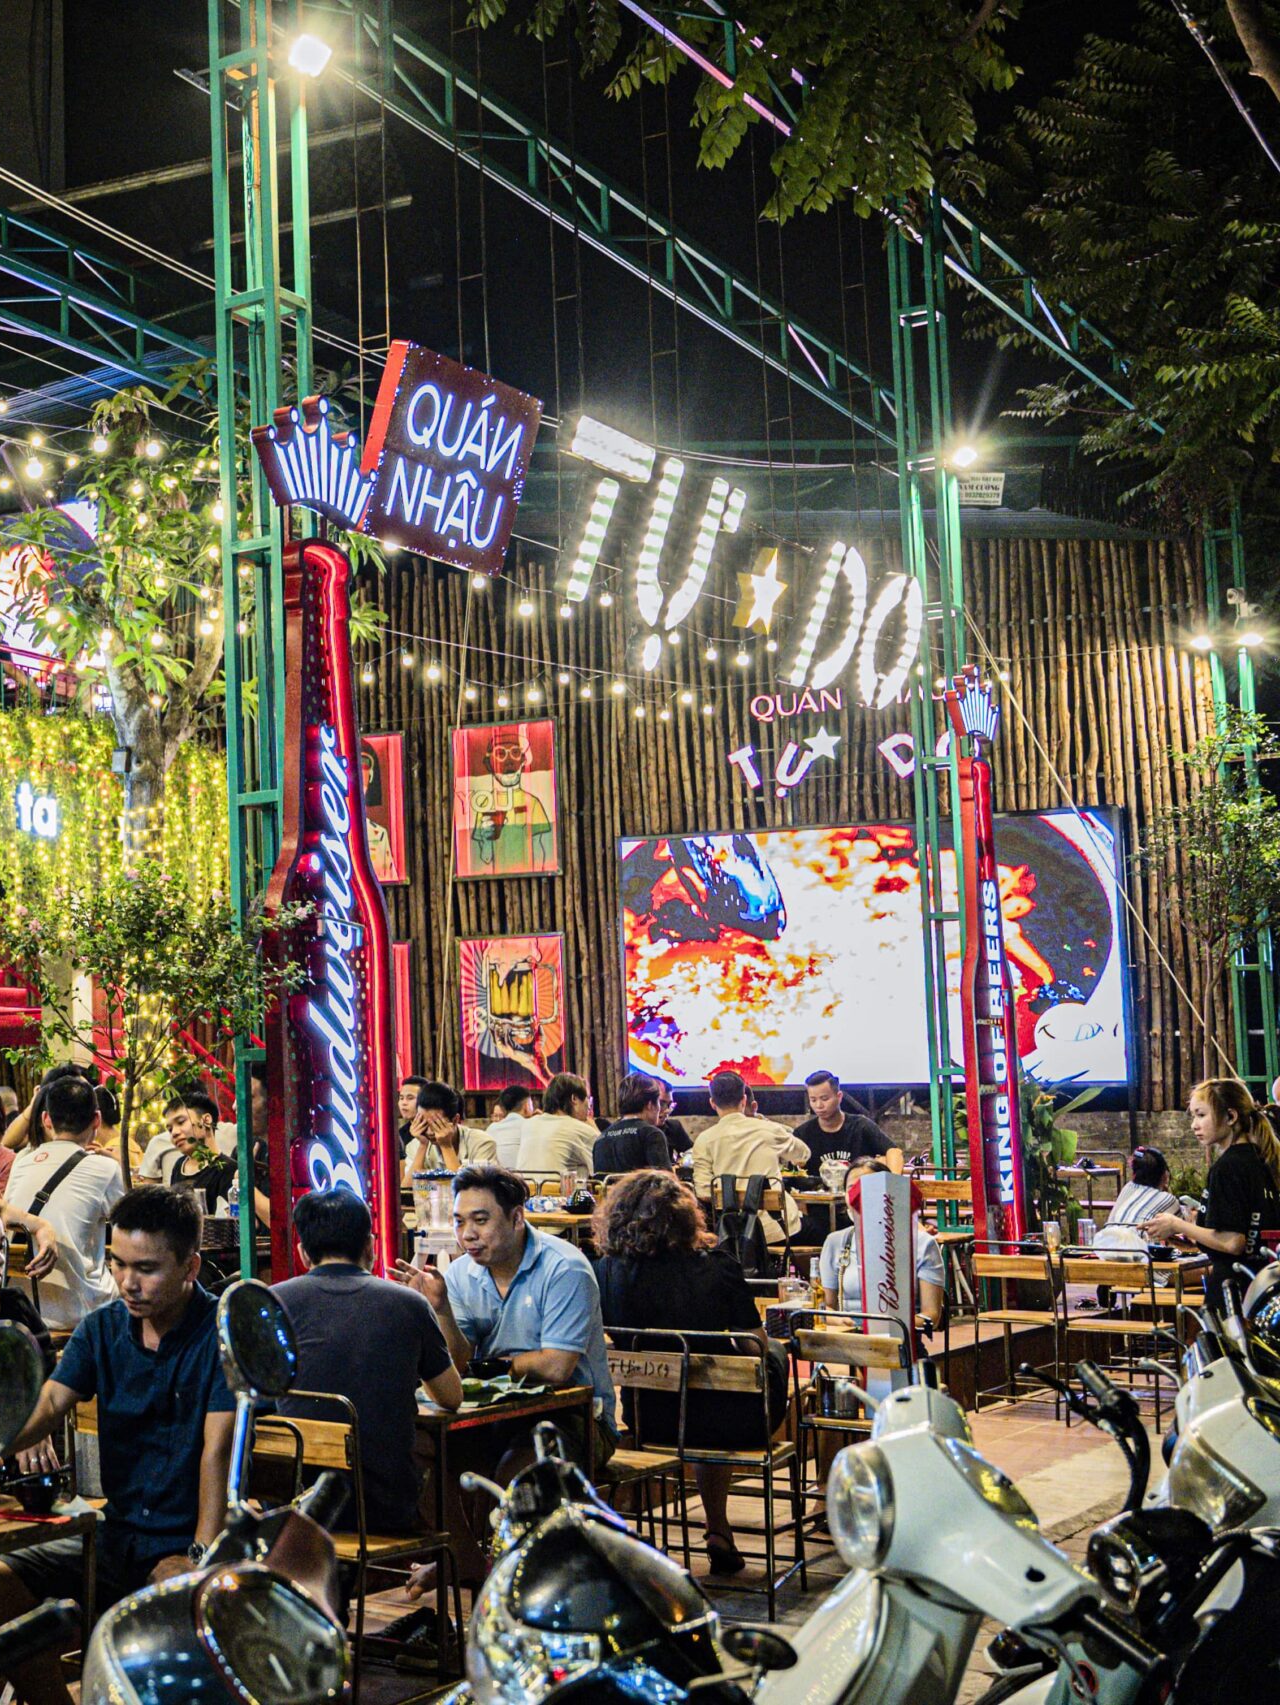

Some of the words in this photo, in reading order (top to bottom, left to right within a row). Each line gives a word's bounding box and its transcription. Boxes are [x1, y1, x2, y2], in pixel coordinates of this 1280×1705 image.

[405, 383, 523, 479] QUÁN
[385, 456, 505, 551] NHẬU
[568, 414, 747, 673] TỰ
[788, 541, 924, 711] DO
[750, 686, 843, 723] QUÁN
[16, 781, 58, 838] ta
[307, 718, 367, 1200] Budweiser
[982, 878, 1006, 1018] BEERS
[990, 1024, 1008, 1084] OF
[994, 1095, 1015, 1204] KING
[877, 1192, 900, 1314] Budweiser
